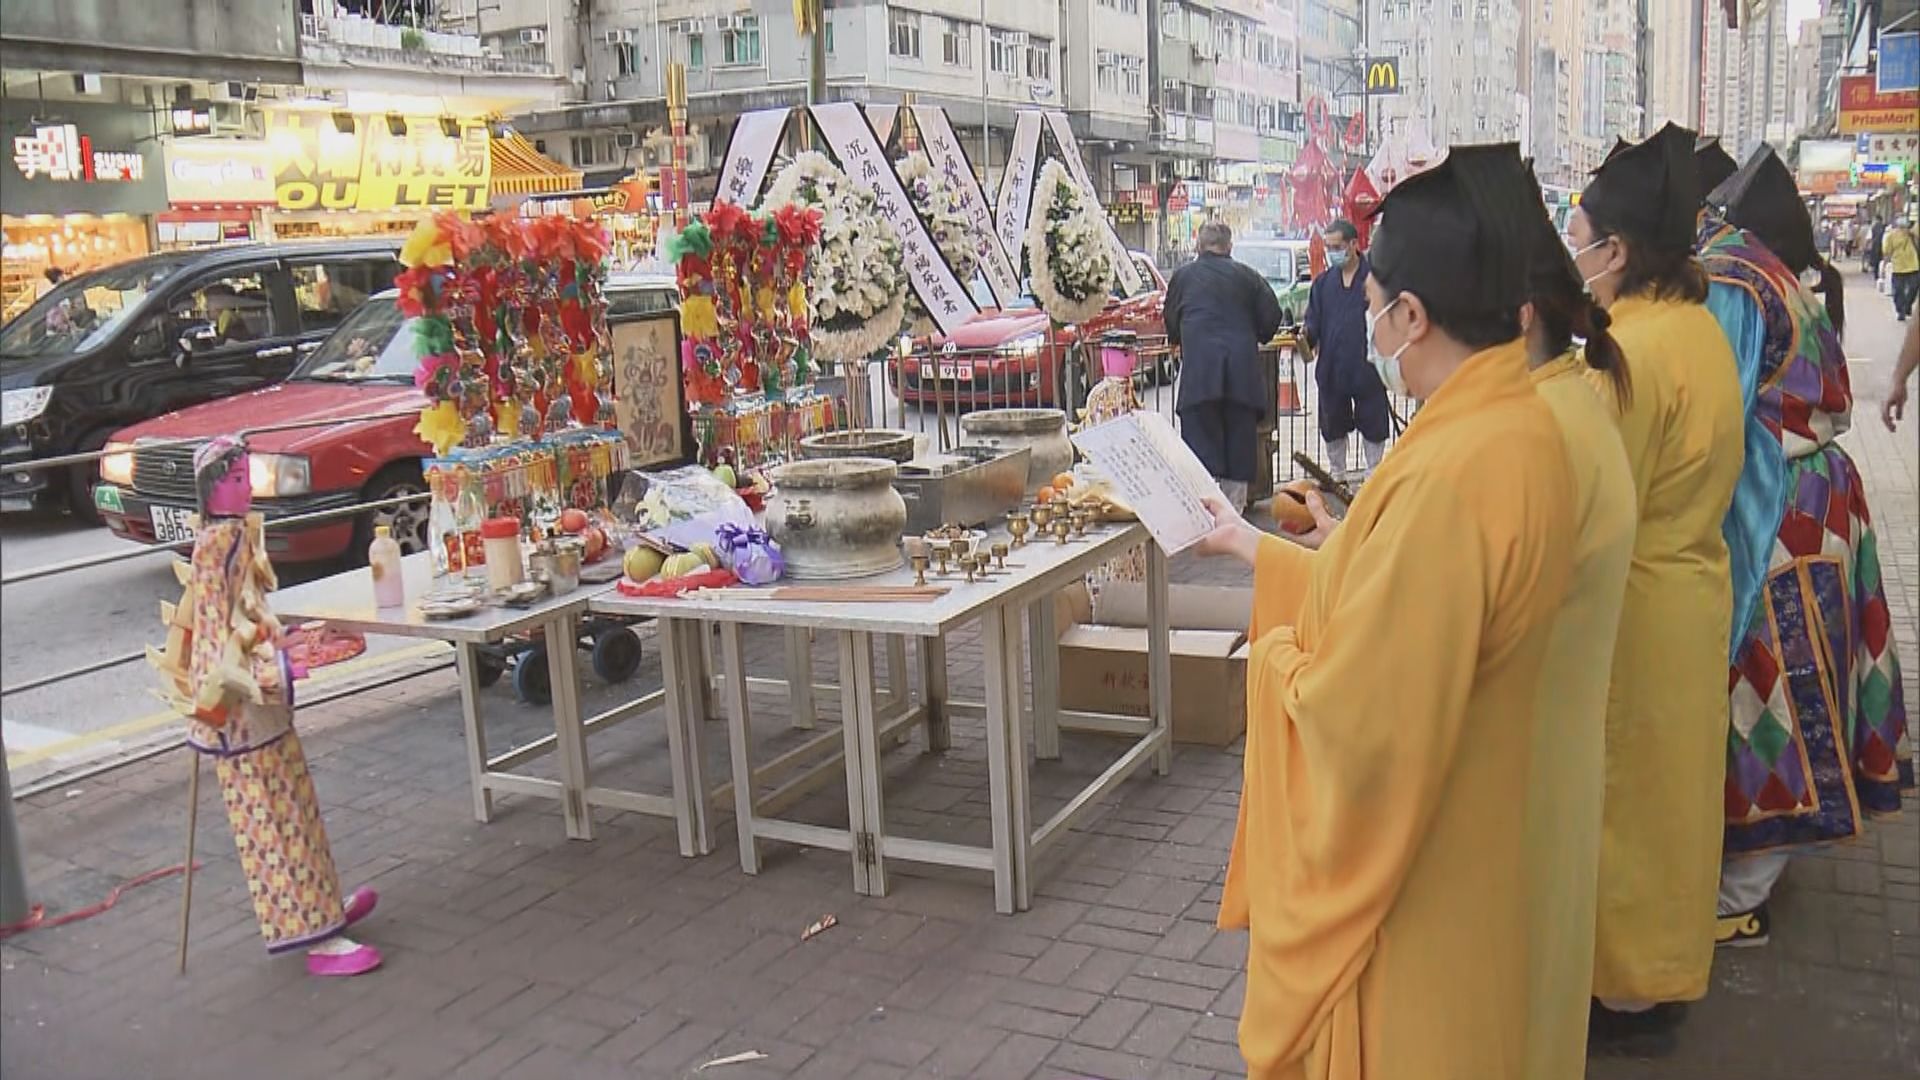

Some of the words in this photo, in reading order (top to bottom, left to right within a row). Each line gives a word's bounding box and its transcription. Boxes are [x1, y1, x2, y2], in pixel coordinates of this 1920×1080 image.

[1851, 113, 1915, 126] PrizeMart
[94, 152, 143, 169] SUSHI
[162, 507, 183, 526] KE
